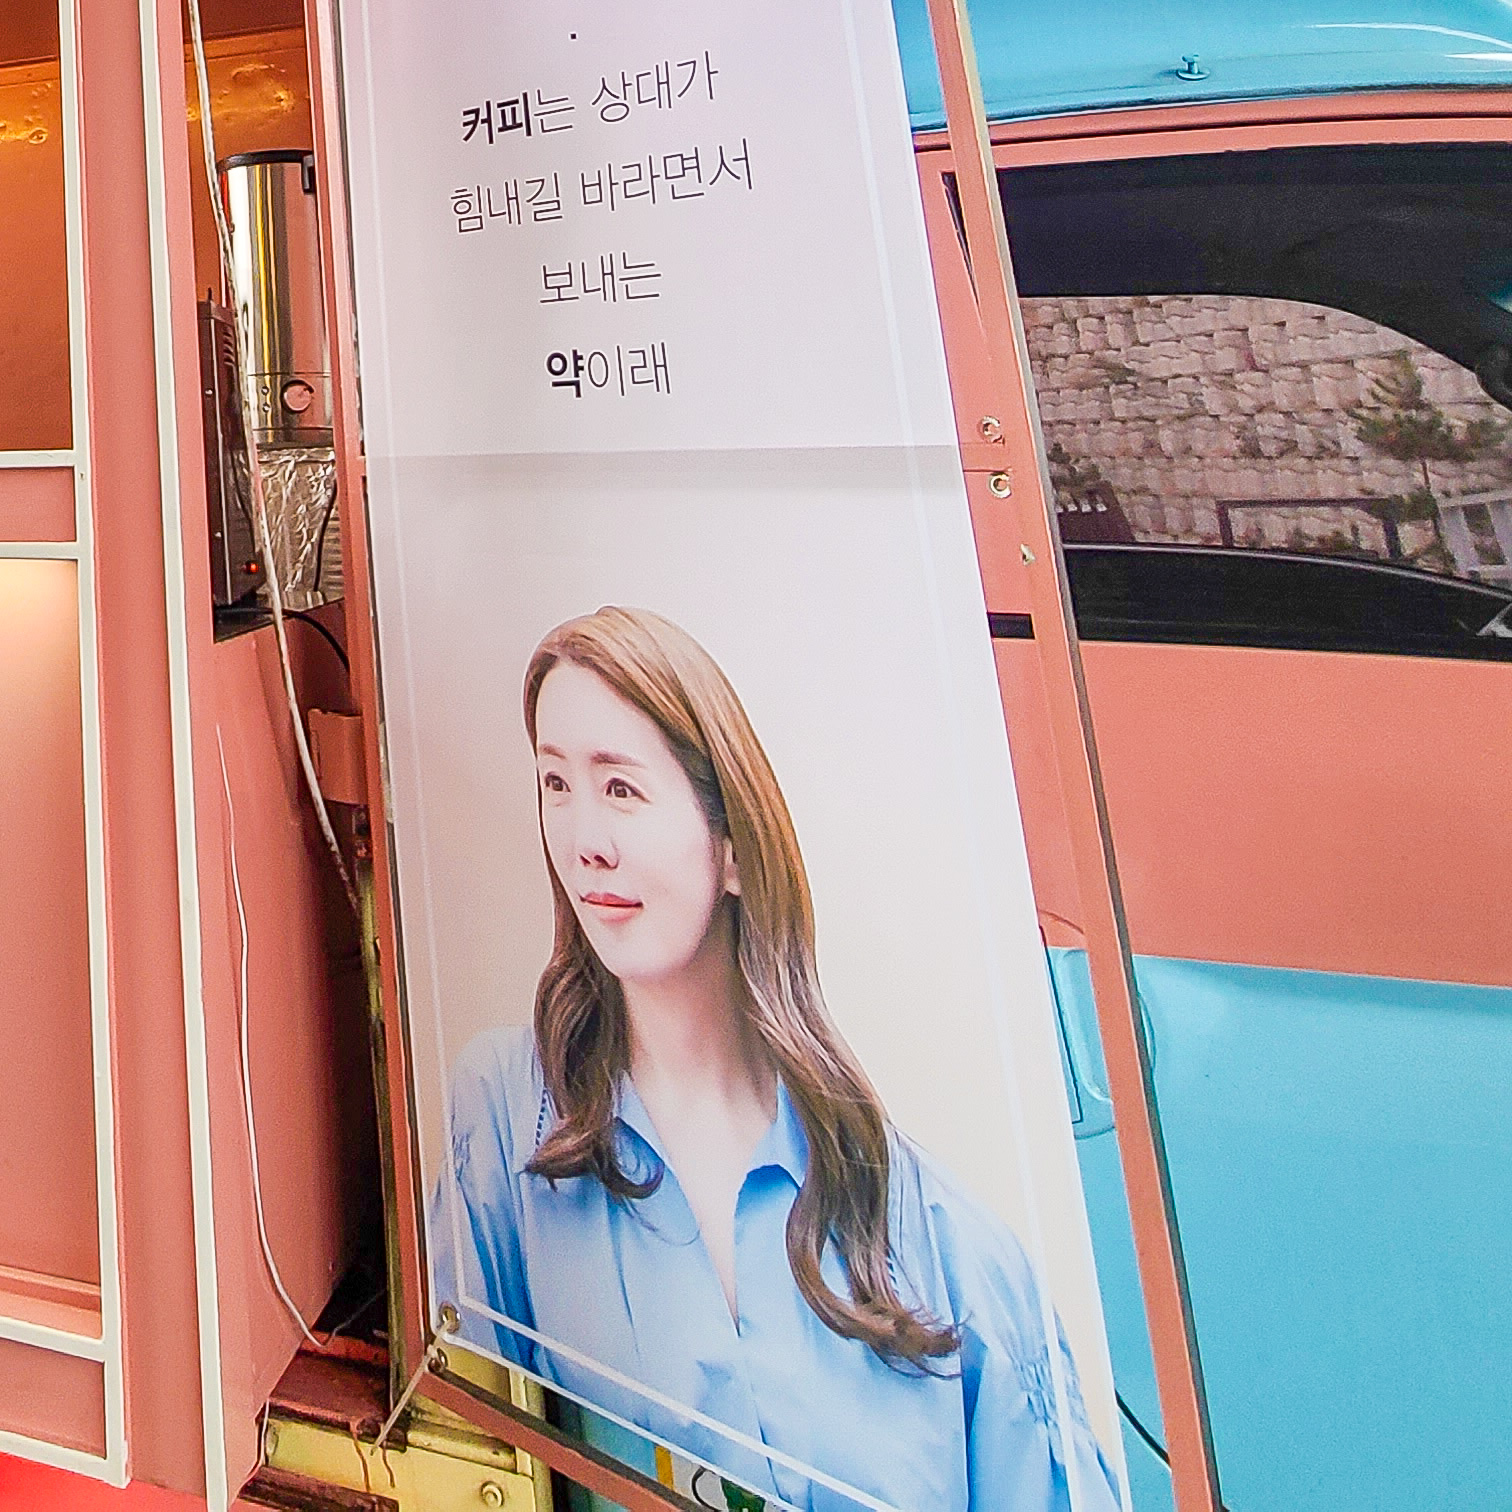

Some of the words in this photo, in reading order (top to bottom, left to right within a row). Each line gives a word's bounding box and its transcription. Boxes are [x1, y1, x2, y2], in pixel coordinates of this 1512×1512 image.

[461, 88, 575, 144] 커피는
[591, 51, 719, 123] 상대가
[450, 172, 564, 232] 힘내길
[580, 138, 753, 211] 바라면서
[540, 252, 662, 303] 보내는
[546, 341, 671, 397] 약이래
